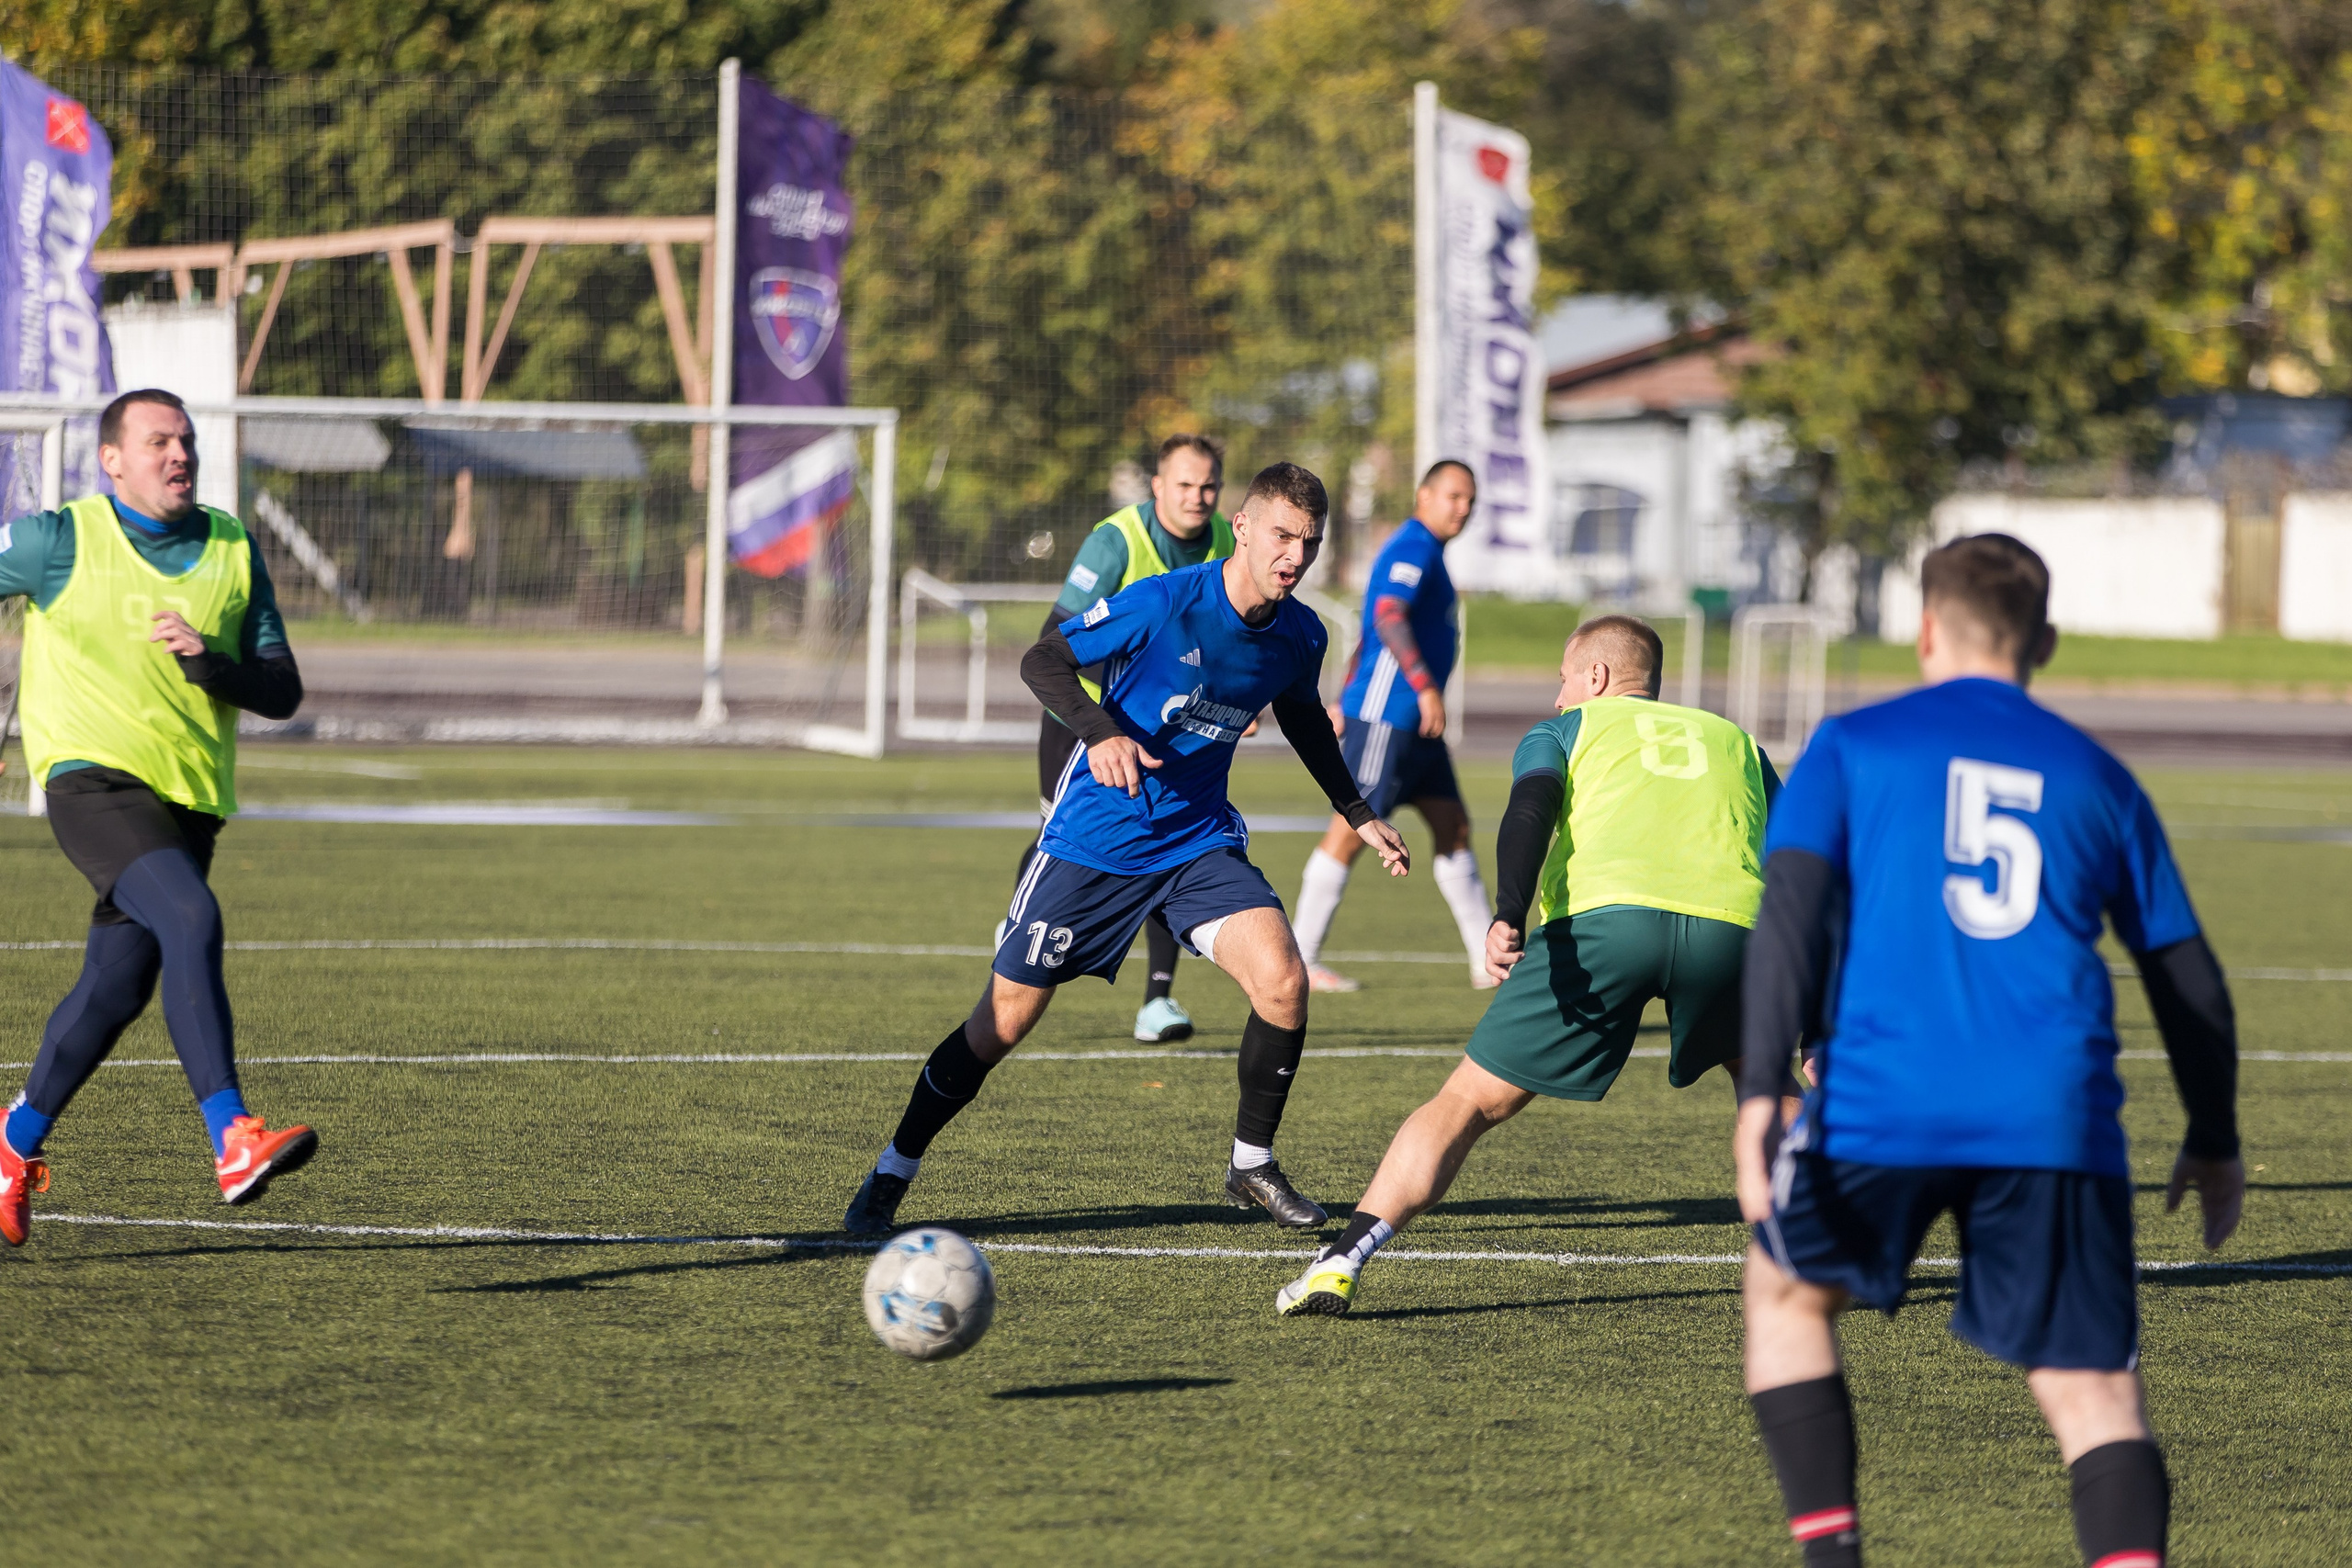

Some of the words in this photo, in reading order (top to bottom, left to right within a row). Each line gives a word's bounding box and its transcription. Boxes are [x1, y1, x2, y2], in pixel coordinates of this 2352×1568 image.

[1191, 699, 1254, 728] ГАЗПРОМ
[1634, 711, 1709, 780] 8
[1942, 755, 2045, 941] 5
[1024, 920, 1074, 969] 13
